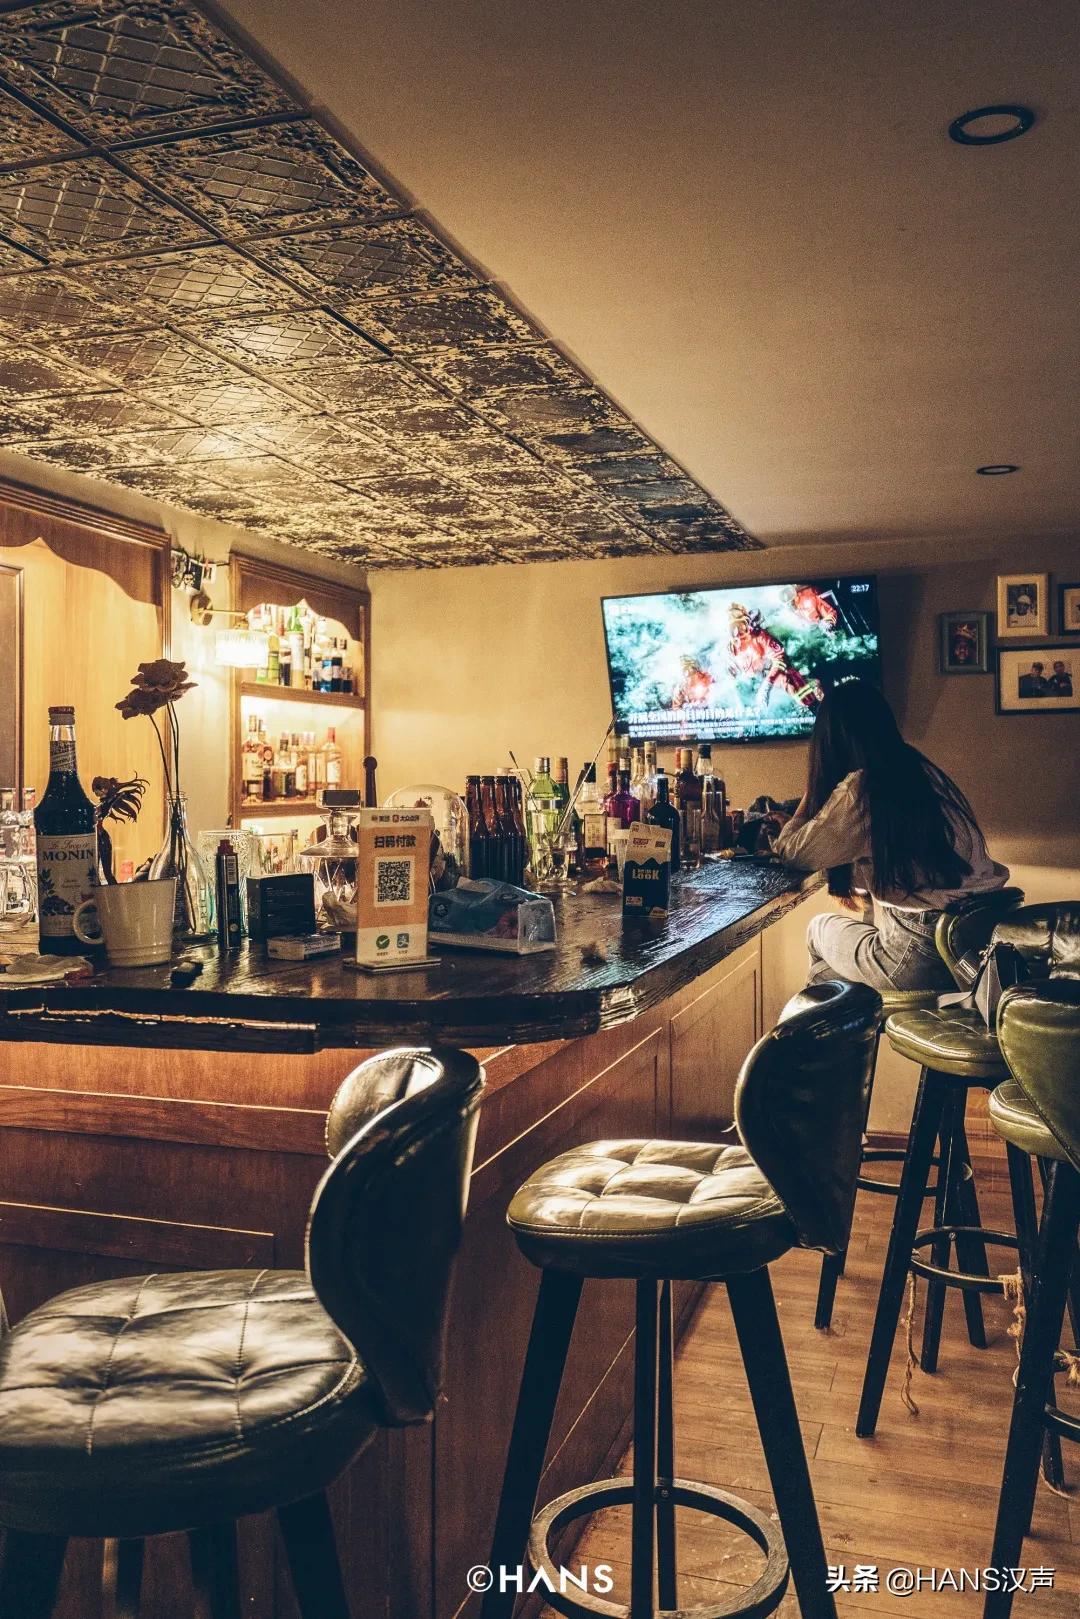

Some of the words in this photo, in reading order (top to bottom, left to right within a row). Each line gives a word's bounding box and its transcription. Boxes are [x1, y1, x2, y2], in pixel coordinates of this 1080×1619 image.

[851, 584, 870, 593] 22:17
[375, 834, 417, 848] 扫码付款
[42, 848, 94, 861] MONIN
